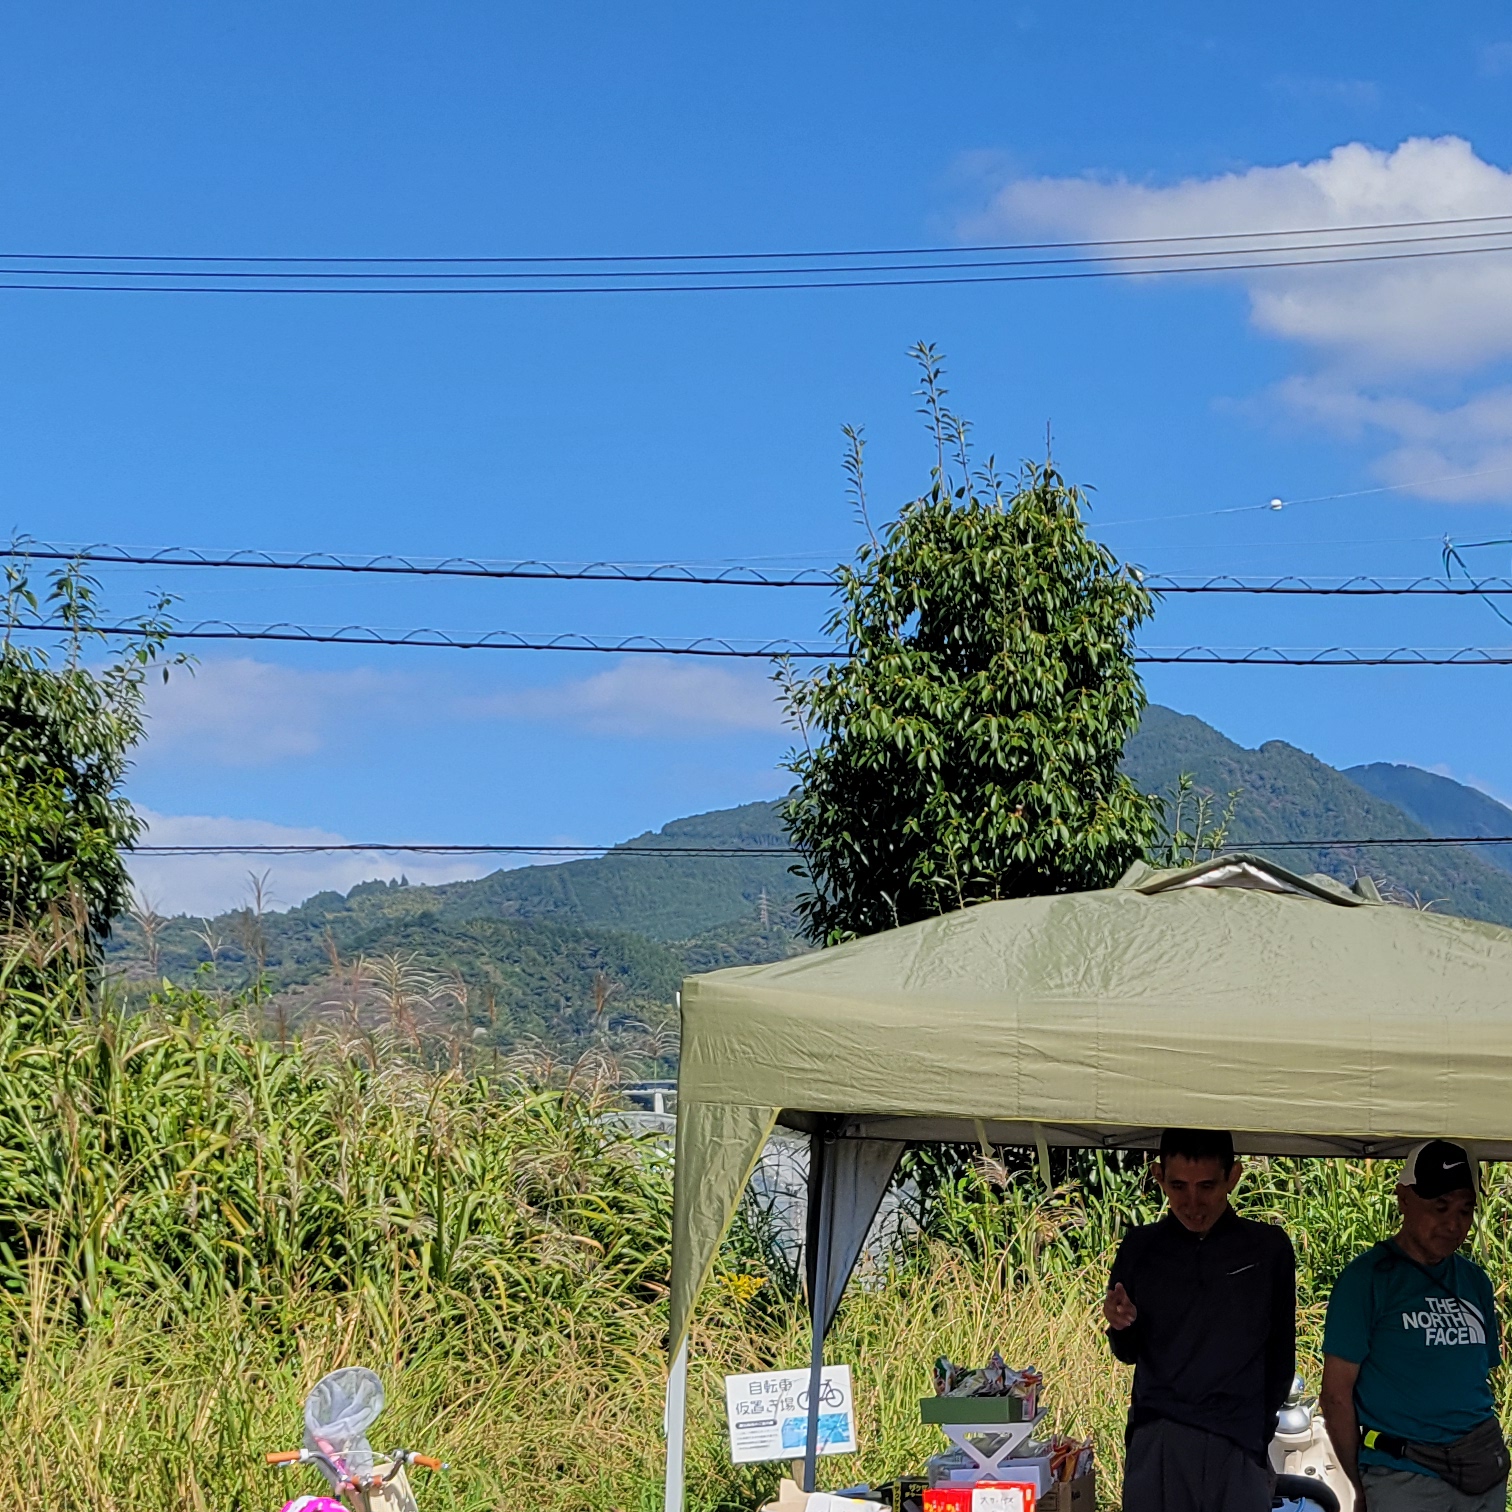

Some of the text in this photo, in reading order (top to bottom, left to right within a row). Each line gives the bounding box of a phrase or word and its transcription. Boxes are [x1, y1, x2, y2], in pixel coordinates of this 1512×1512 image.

[1425, 1297, 1460, 1313] THE
[1402, 1312, 1466, 1330] NORTH
[1425, 1327, 1469, 1346] FACE
[749, 1379, 793, 1395] 自転車
[736, 1397, 796, 1415] 仮置き場
